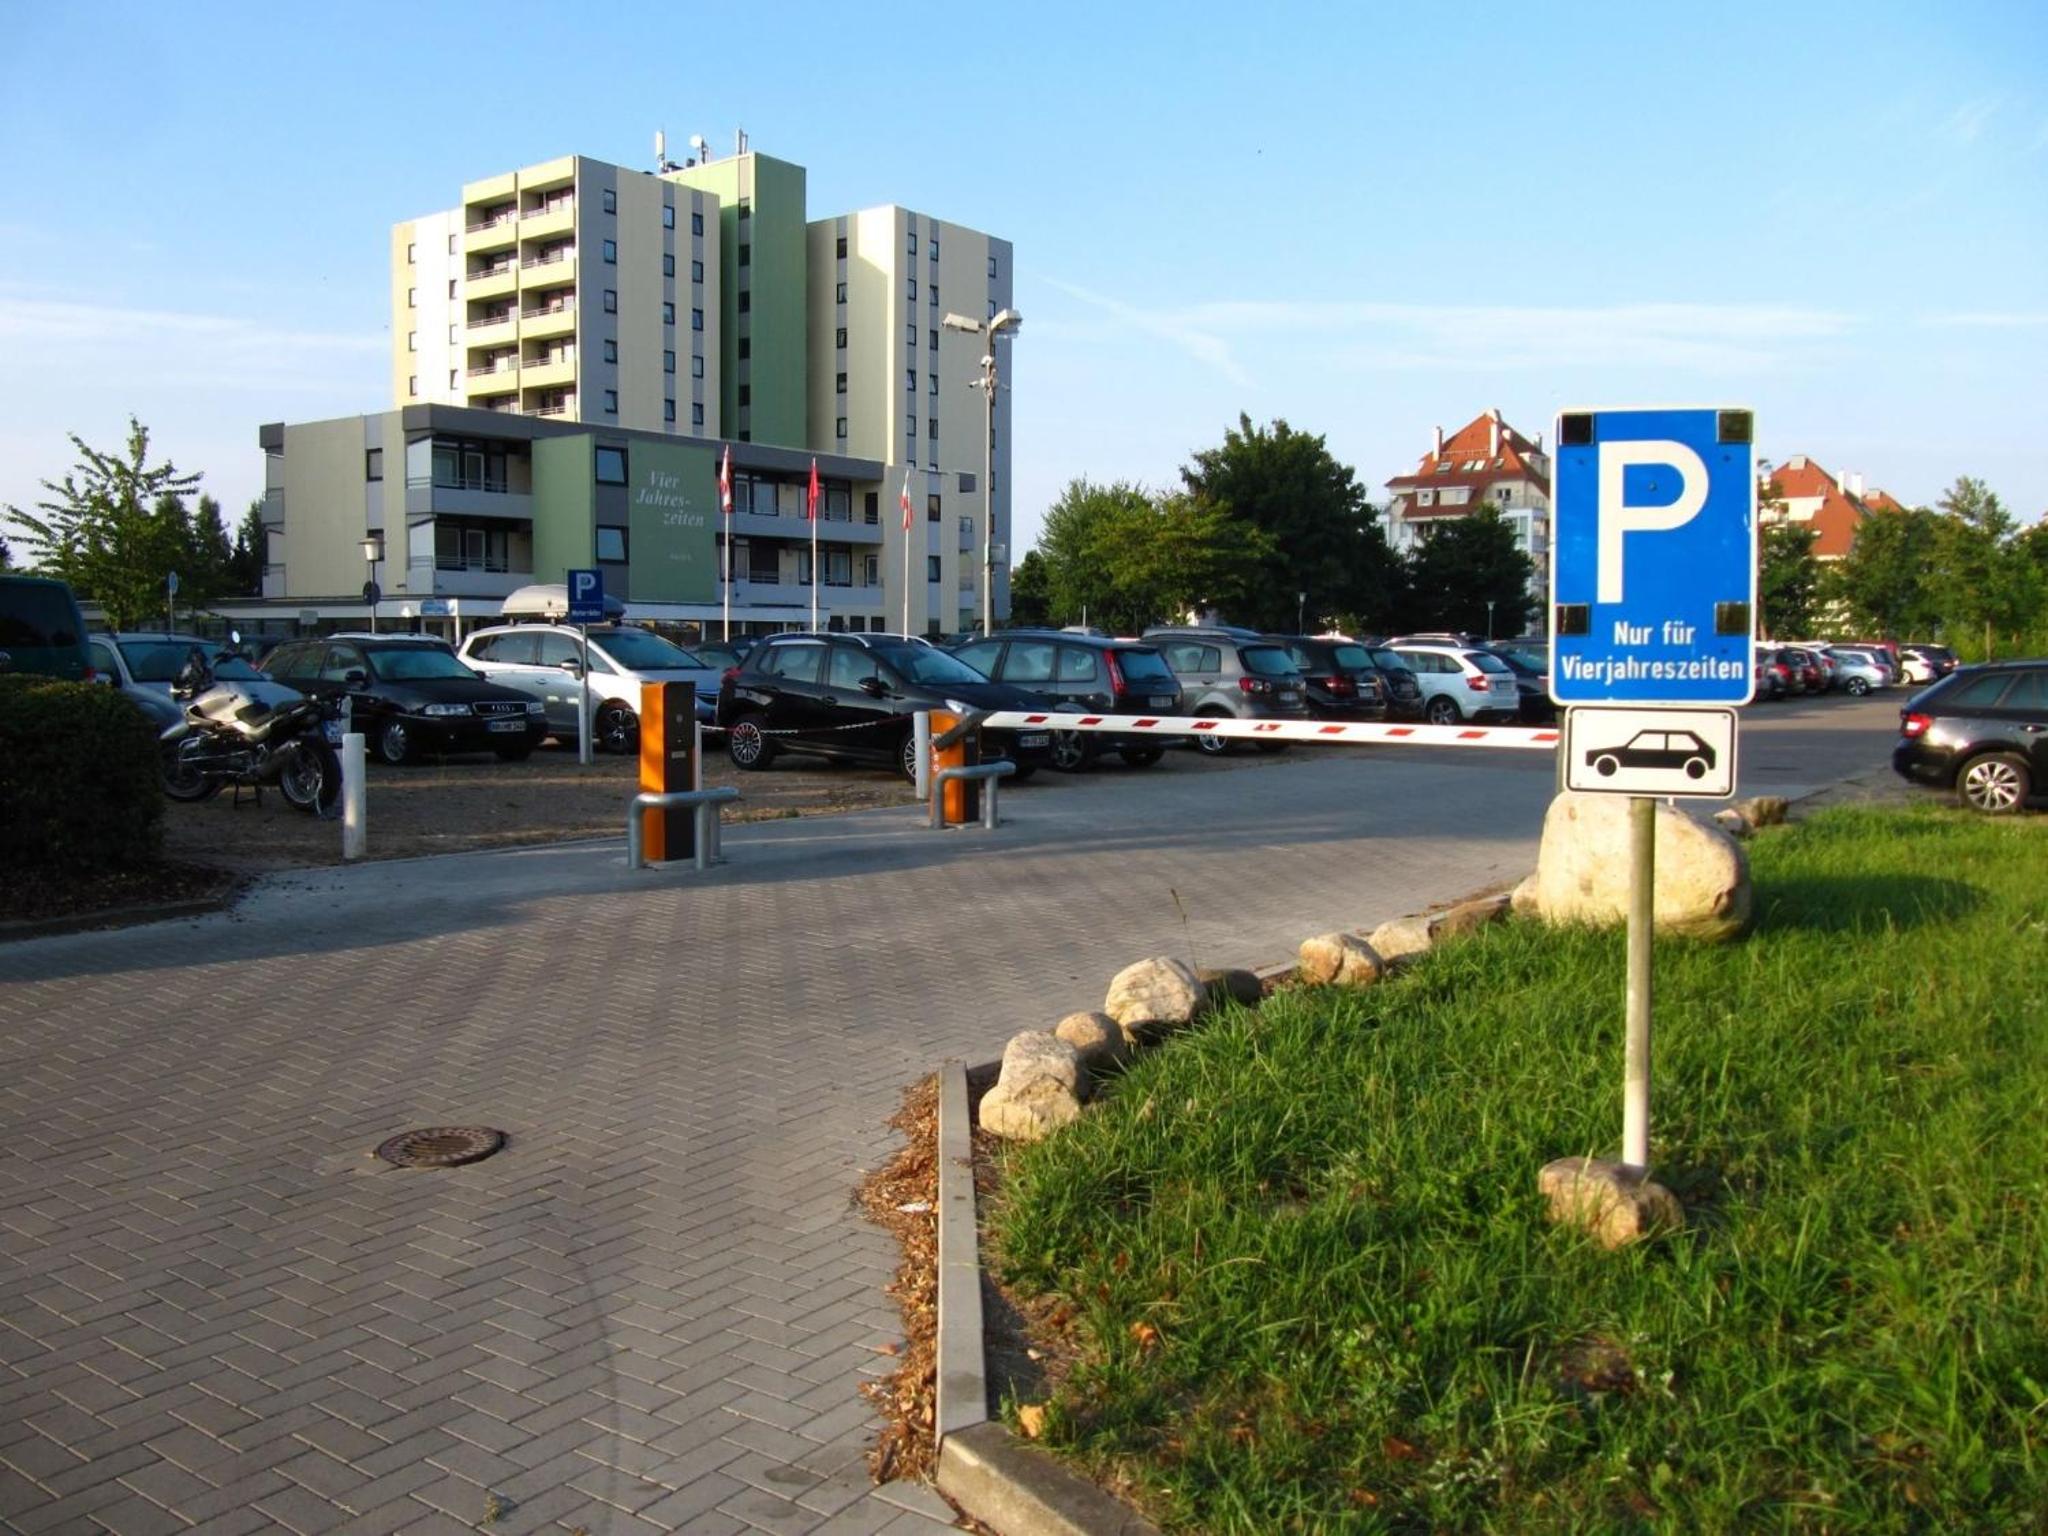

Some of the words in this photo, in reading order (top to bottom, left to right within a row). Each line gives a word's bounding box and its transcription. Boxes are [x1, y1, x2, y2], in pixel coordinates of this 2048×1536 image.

[649, 470, 681, 488] Vier
[663, 509, 704, 527] zeiten
[1597, 440, 1709, 603] P
[576, 573, 596, 600] P
[1613, 621, 1653, 645] Nur
[1662, 620, 1696, 645] für
[1561, 655, 1744, 686] Vierjahreszeiten
